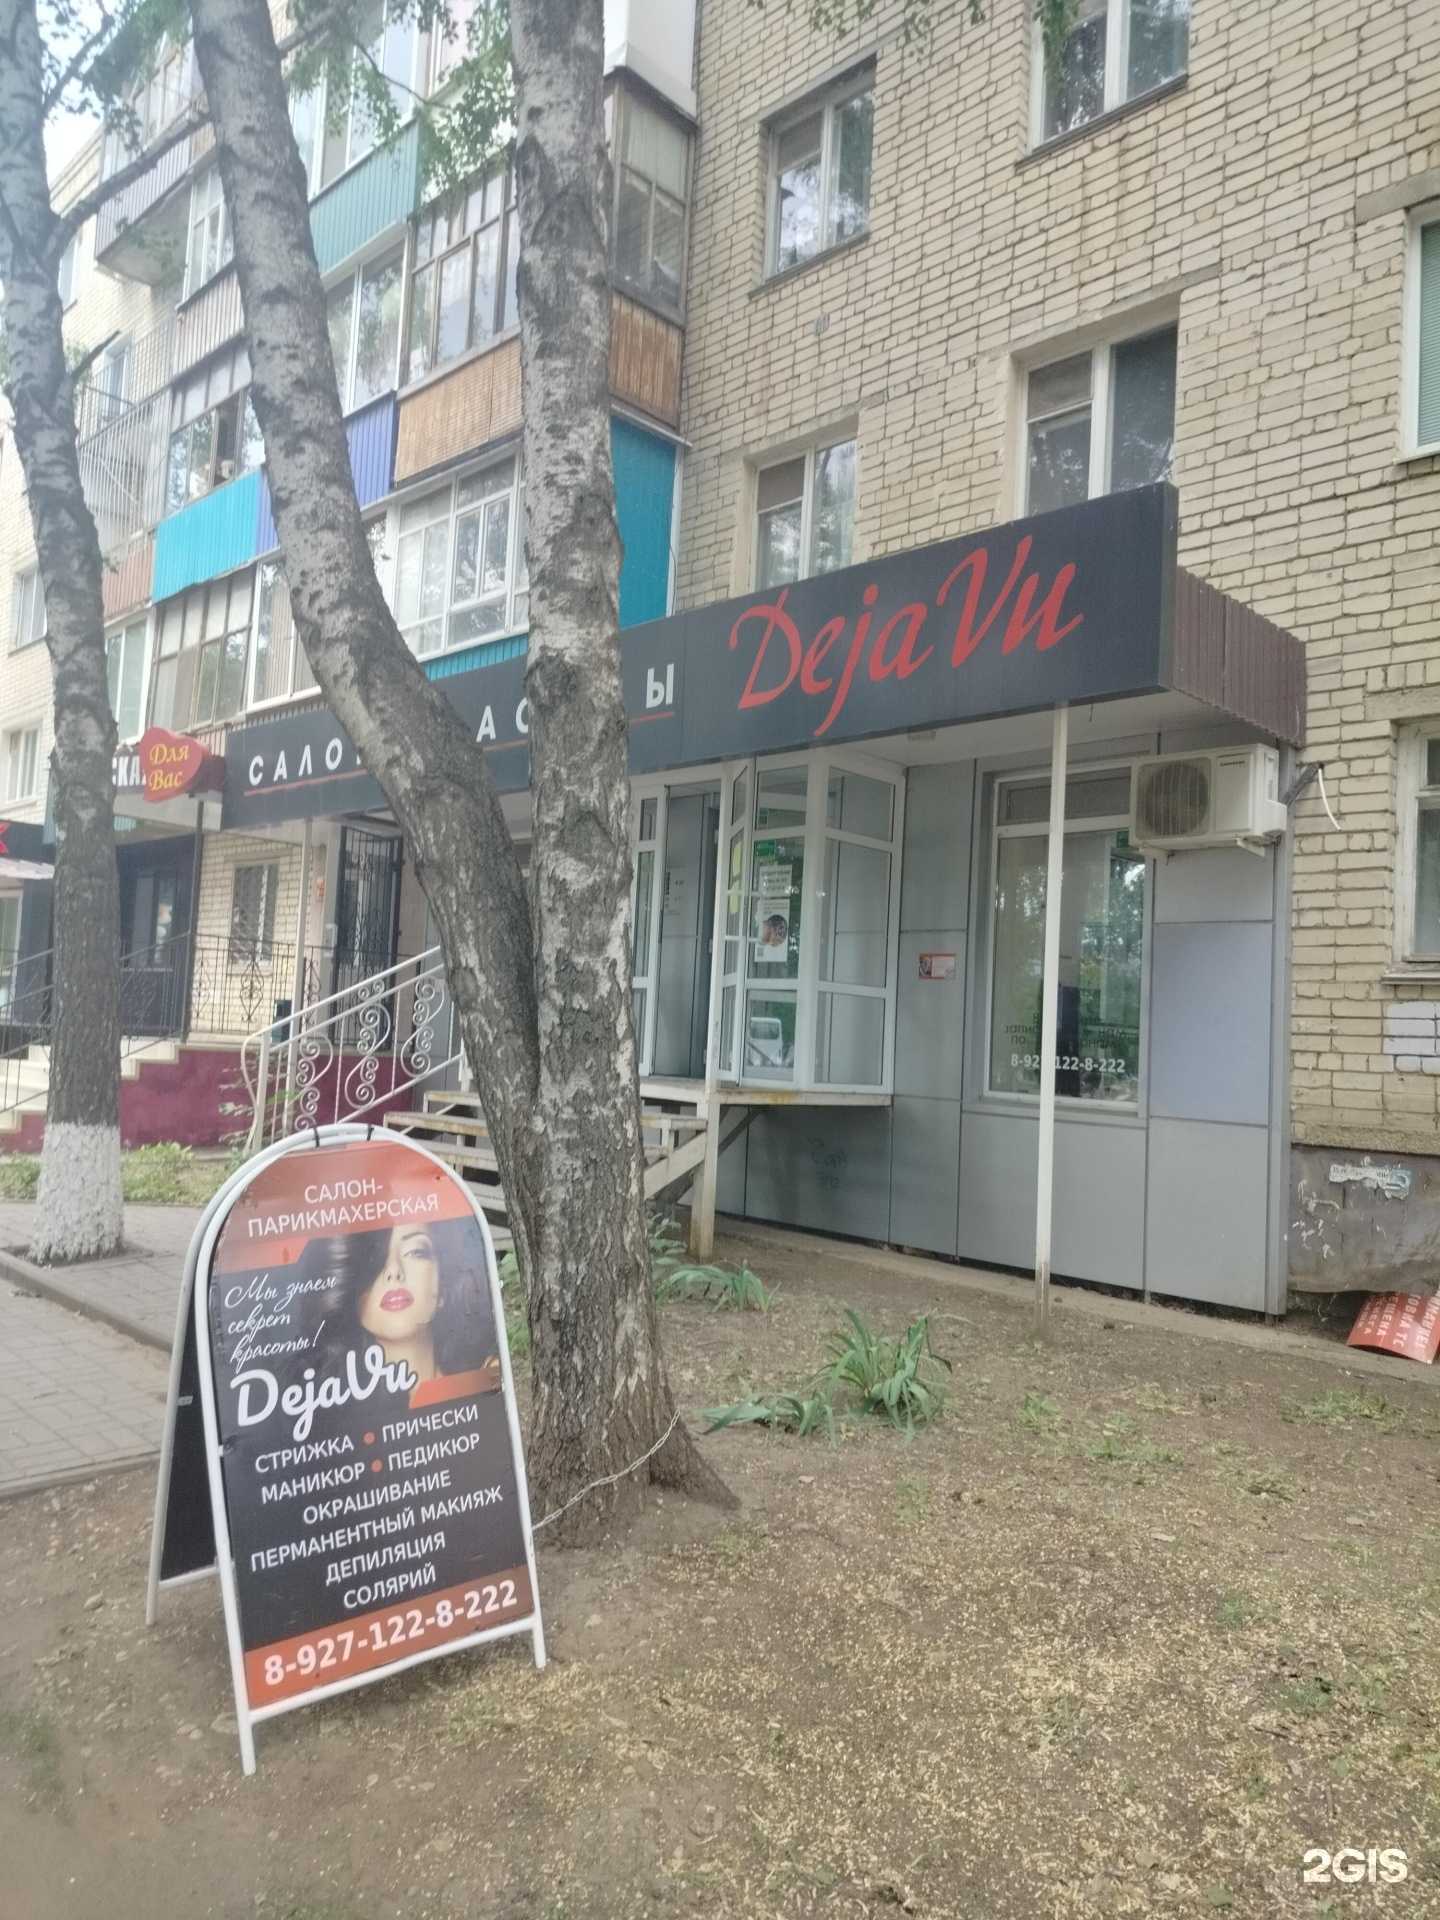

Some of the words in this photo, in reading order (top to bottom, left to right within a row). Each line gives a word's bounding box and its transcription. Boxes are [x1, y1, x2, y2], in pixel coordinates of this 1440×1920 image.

[149, 744, 189, 765] Для
[248, 737, 362, 786] САЛО
[149, 769, 183, 792] Вас
[247, 1193, 440, 1239] ПАРИКМАХЕРСКАЯ
[304, 1178, 384, 1205] САЛОН-
[224, 1273, 278, 1309] Мы
[273, 1276, 337, 1313] знаем
[228, 1303, 291, 1343] секрет
[229, 1319, 326, 1375] красоты!
[254, 1435, 355, 1473] СТРИЖКА
[381, 1404, 480, 1443] ПРИЧЕСКИ
[261, 1462, 366, 1505] МАНИКЮР
[387, 1432, 481, 1472] ПЕДИКЮР
[302, 1469, 452, 1526] ОКРАШИВАНИЕ
[250, 1507, 416, 1573] ПЕРМАНЕНТНЫЙ
[420, 1485, 505, 1523] МАКИЯЖ
[324, 1531, 447, 1587] ДЕПИЛЯЦИЯ
[342, 1563, 437, 1610] СОЛЯРИЙ
[263, 1578, 518, 1686] 8-927-122-8-222
